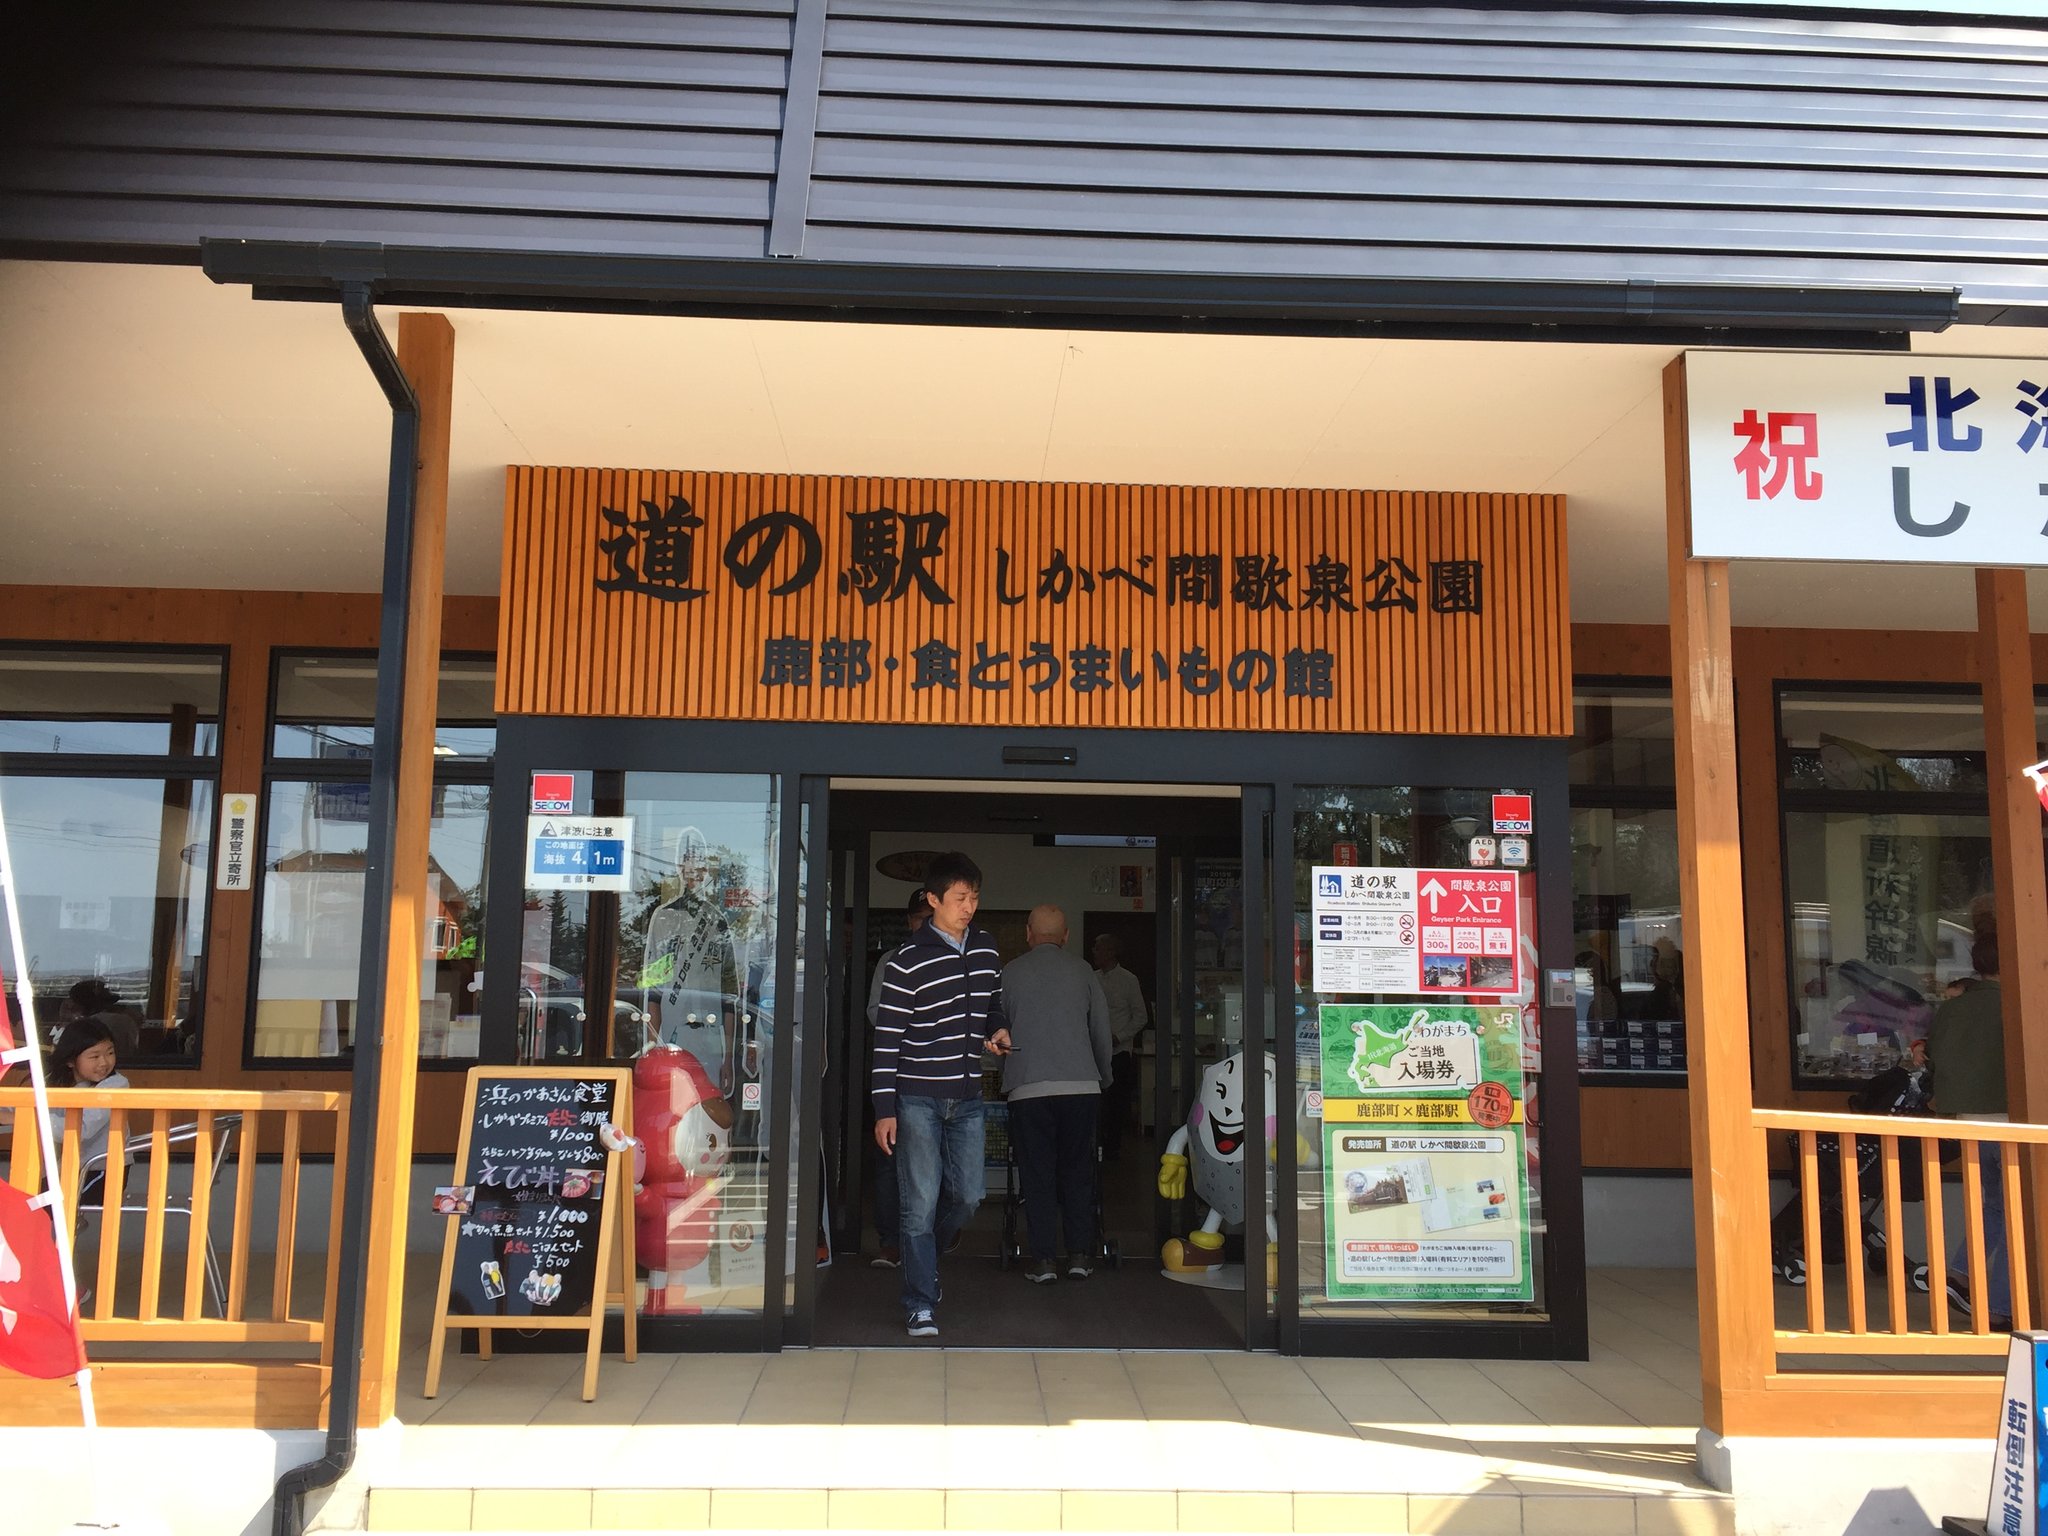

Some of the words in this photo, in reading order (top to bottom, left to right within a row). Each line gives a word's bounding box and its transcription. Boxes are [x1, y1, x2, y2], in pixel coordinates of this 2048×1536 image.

[1733, 409, 1823, 501] 祝
[595, 495, 956, 606] 道の駅
[995, 547, 1484, 615] しかべ間歇泉公園
[759, 635, 1335, 700] 鹿部・食とうまいもの館
[535, 801, 570, 810] SECOM
[560, 826, 614, 837] 津波に注意
[1496, 821, 1530, 830] SECOM
[226, 817, 245, 886] 警察官立寄所
[1350, 874, 1397, 889] 道の駅
[1450, 879, 1512, 892] 間歇泉公園
[1458, 893, 1502, 914] 入口
[1431, 915, 1455, 923] Geyser
[1493, 1012, 1514, 1024] JR
[1420, 1024, 1467, 1038] わがまち
[1408, 1045, 1445, 1058] ご当地
[1398, 1060, 1455, 1080] 入場券
[1391, 1140, 1416, 1149] 道の駅
[477, 1158, 560, 1196] えび丼
[532, 1253, 571, 1269] ¥500
